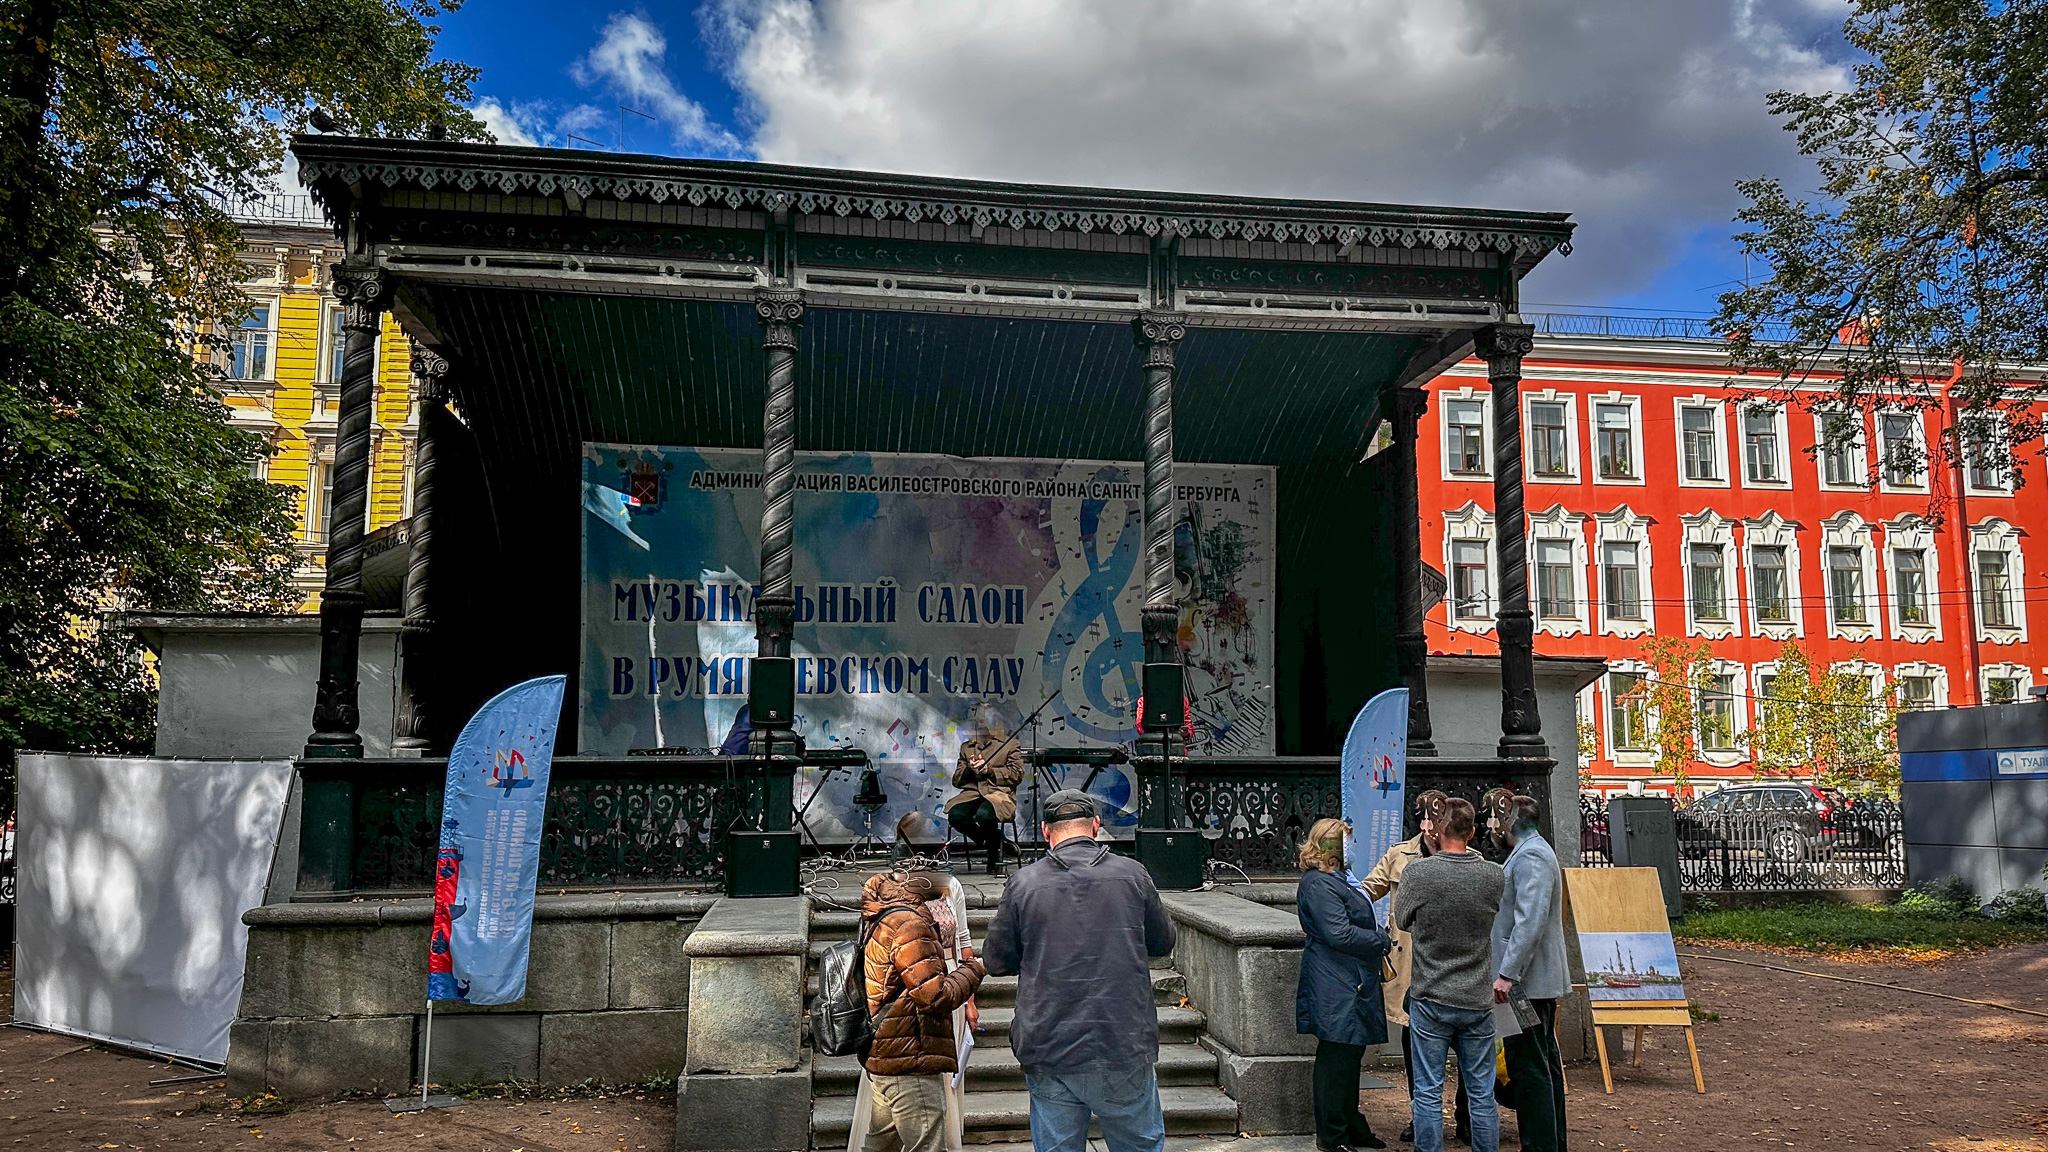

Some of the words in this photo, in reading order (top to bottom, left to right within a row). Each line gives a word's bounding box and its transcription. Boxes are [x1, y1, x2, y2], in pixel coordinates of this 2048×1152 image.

[690, 471, 841, 491] АДМИНИАЦИЯ
[849, 475, 1021, 496] ВАСИЛЕОСТРОВСКОГО
[1026, 478, 1087, 498] РАЙОНА
[1092, 482, 1241, 503] САНКТ-ЕРБУРГА
[613, 580, 897, 624] МУЗЫКАЬНЫЙ
[917, 584, 1025, 625] САЛОН
[611, 656, 635, 696] В
[647, 655, 930, 696] РУМЯЕВСКОМ
[942, 655, 1025, 700] САДУ
[485, 809, 497, 840] РАЙОН
[490, 870, 504, 915] детского
[486, 917, 499, 939] Дом
